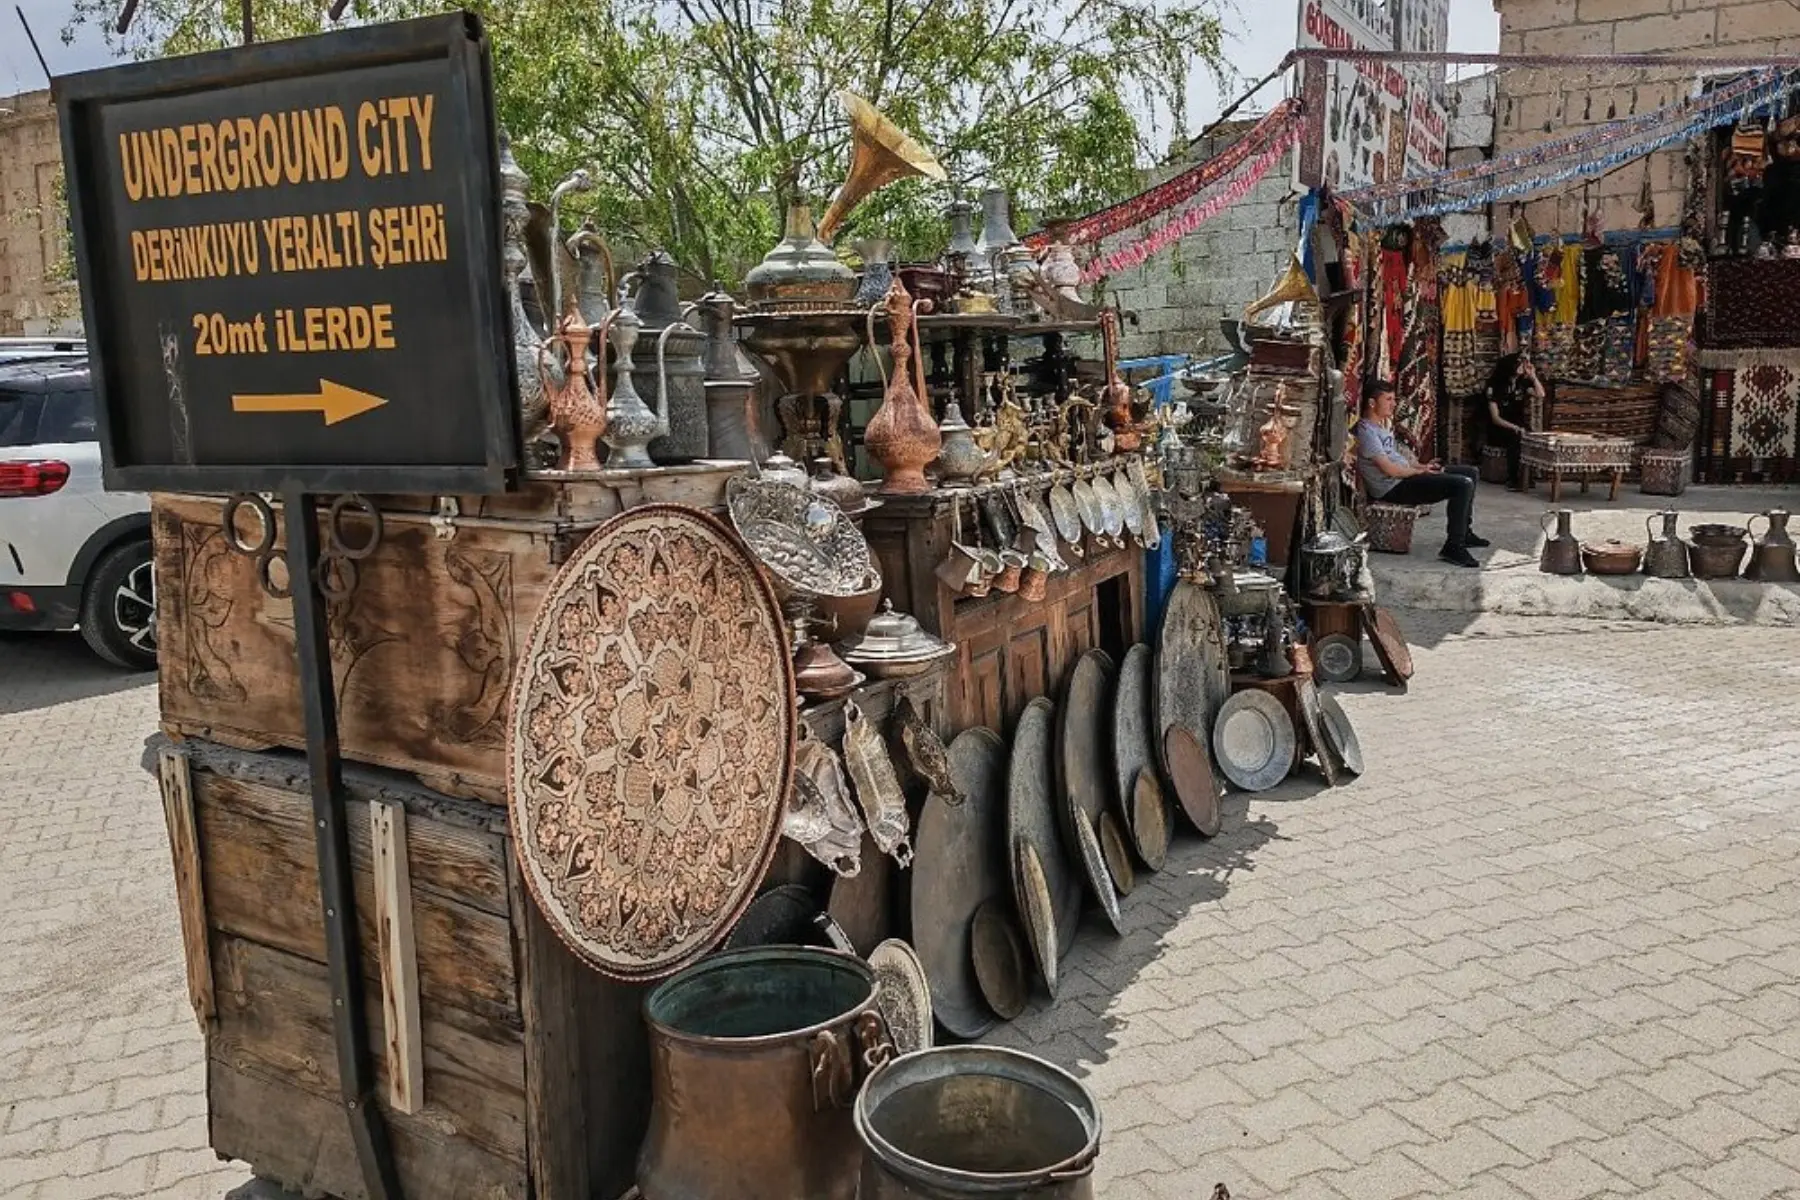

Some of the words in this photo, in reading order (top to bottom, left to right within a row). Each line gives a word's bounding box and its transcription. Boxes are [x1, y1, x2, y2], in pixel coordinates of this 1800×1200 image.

[120, 106, 348, 201] UNDERGROUND
[263, 210, 364, 272] YERALTI
[193, 313, 267, 355] 20mt
